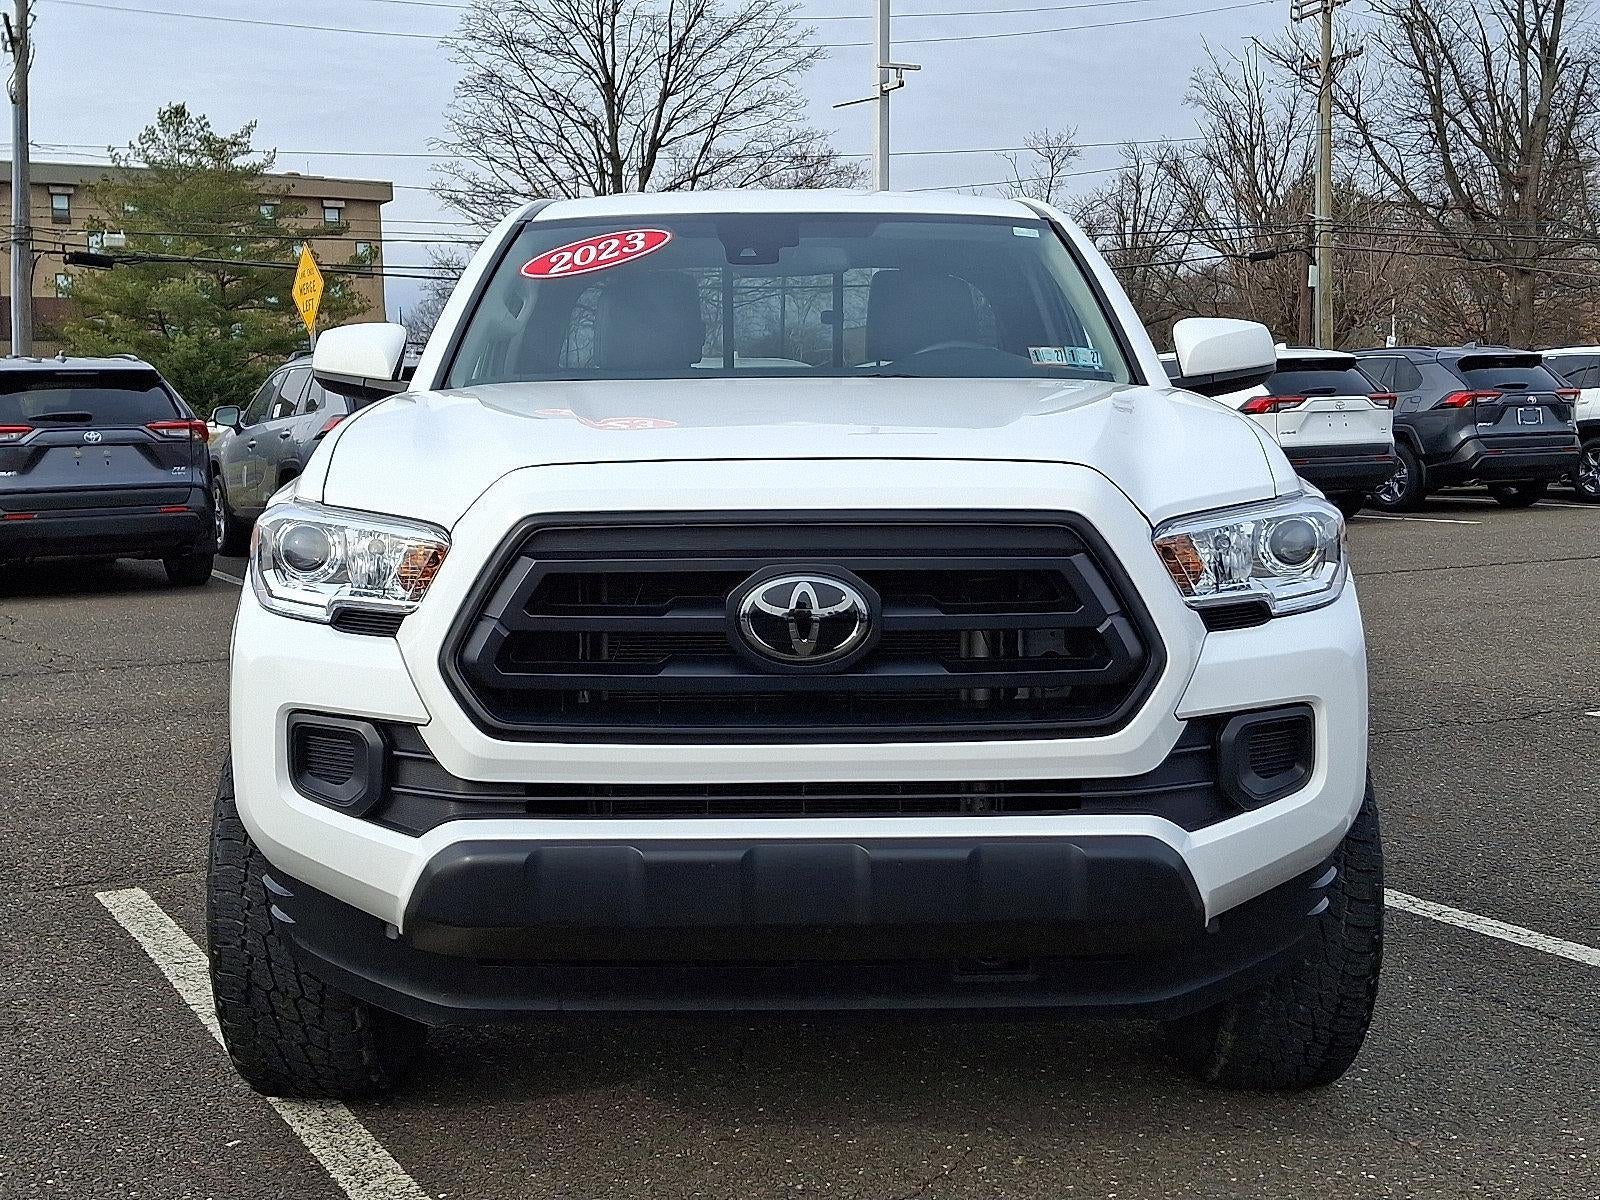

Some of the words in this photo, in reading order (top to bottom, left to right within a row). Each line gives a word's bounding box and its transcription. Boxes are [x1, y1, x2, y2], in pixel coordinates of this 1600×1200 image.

[549, 232, 646, 274] 2023
[299, 280, 317, 297] MERGE
[302, 298, 314, 313] LEFT
